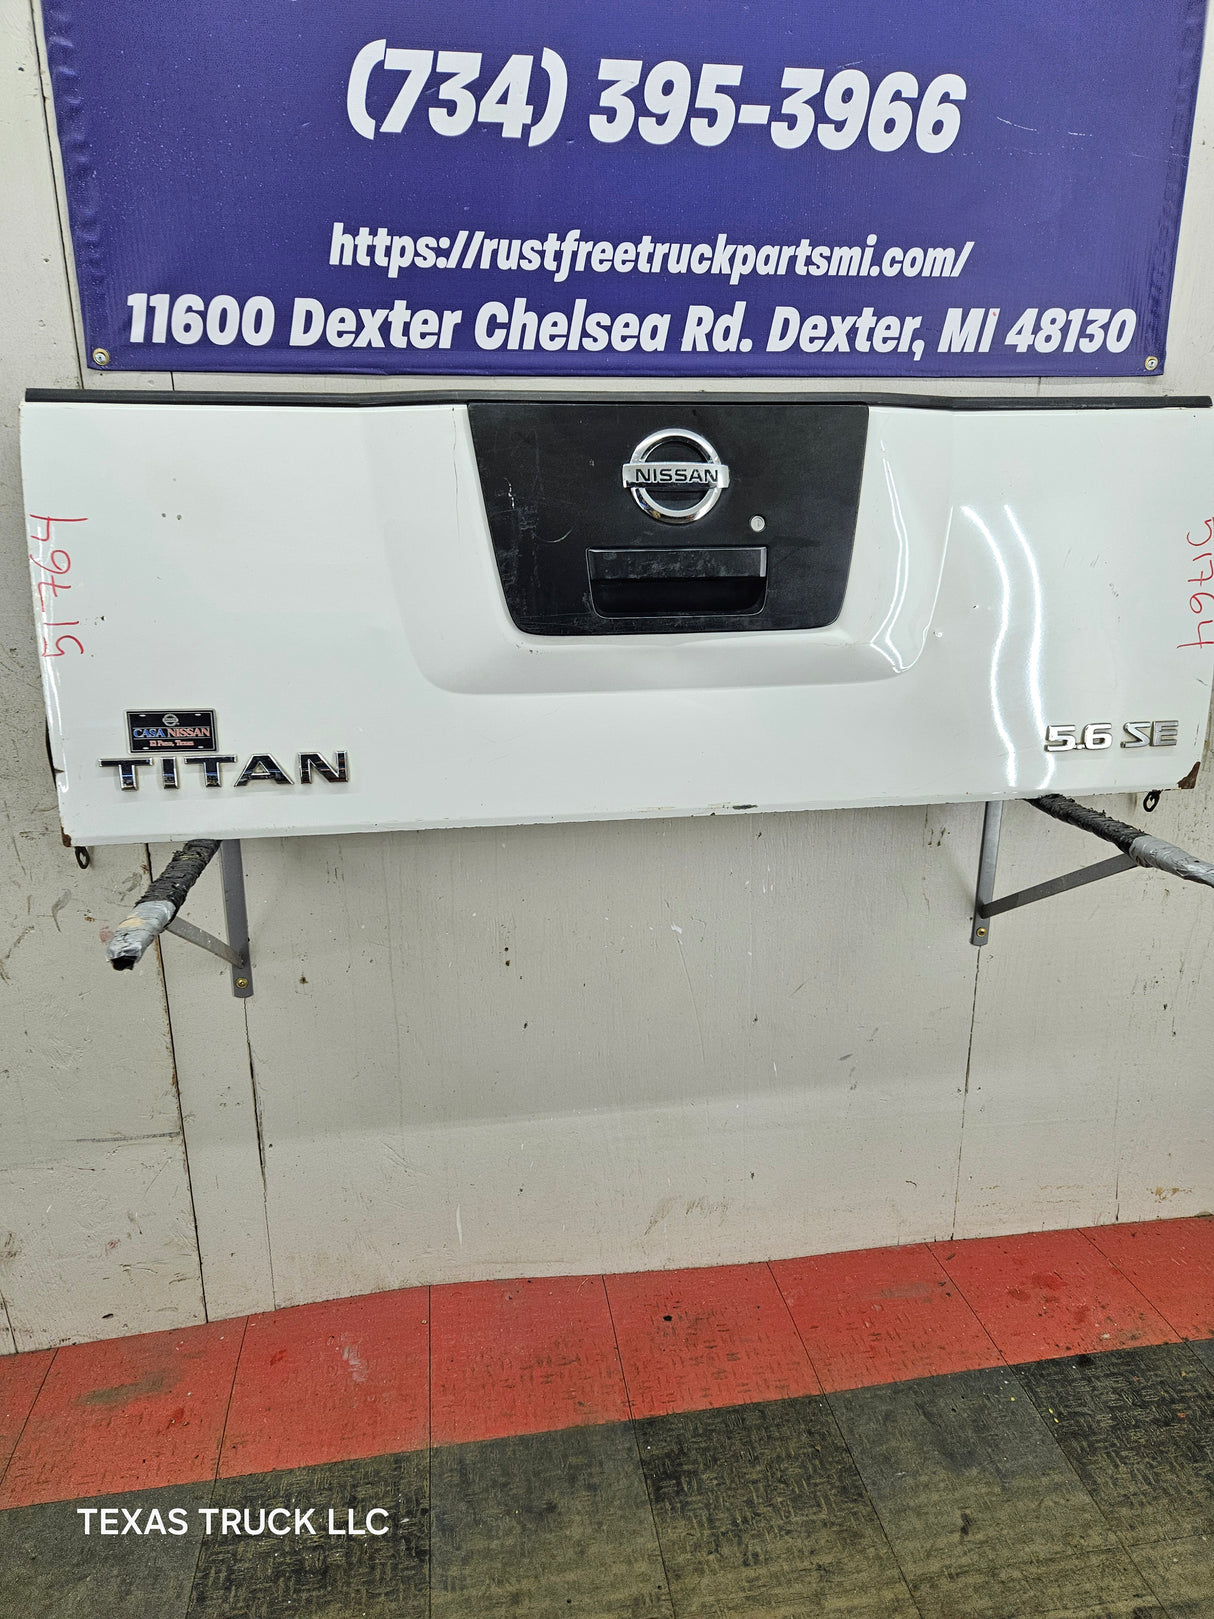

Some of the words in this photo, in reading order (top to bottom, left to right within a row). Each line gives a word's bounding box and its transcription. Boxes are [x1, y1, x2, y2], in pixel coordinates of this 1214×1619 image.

[346, 38, 568, 148] (734)
[588, 58, 967, 154] 395-3966
[328, 221, 976, 286] https://rustfreetruckpartsmi.com/
[126, 292, 275, 347] 11600
[289, 297, 463, 350] Dexter
[474, 298, 672, 352] Chelsea
[680, 300, 753, 353] Rd.
[765, 305, 925, 362] Dexter,
[936, 307, 1001, 353] MI
[1004, 307, 1137, 354] 48130
[634, 467, 720, 485] NISSAN
[30, 514, 88, 657] 51764
[133, 728, 165, 738] CASA
[167, 728, 210, 737] NISSAN
[1045, 722, 1113, 753] 5.6
[1121, 719, 1180, 749] SE
[99, 751, 349, 791] TITAN
